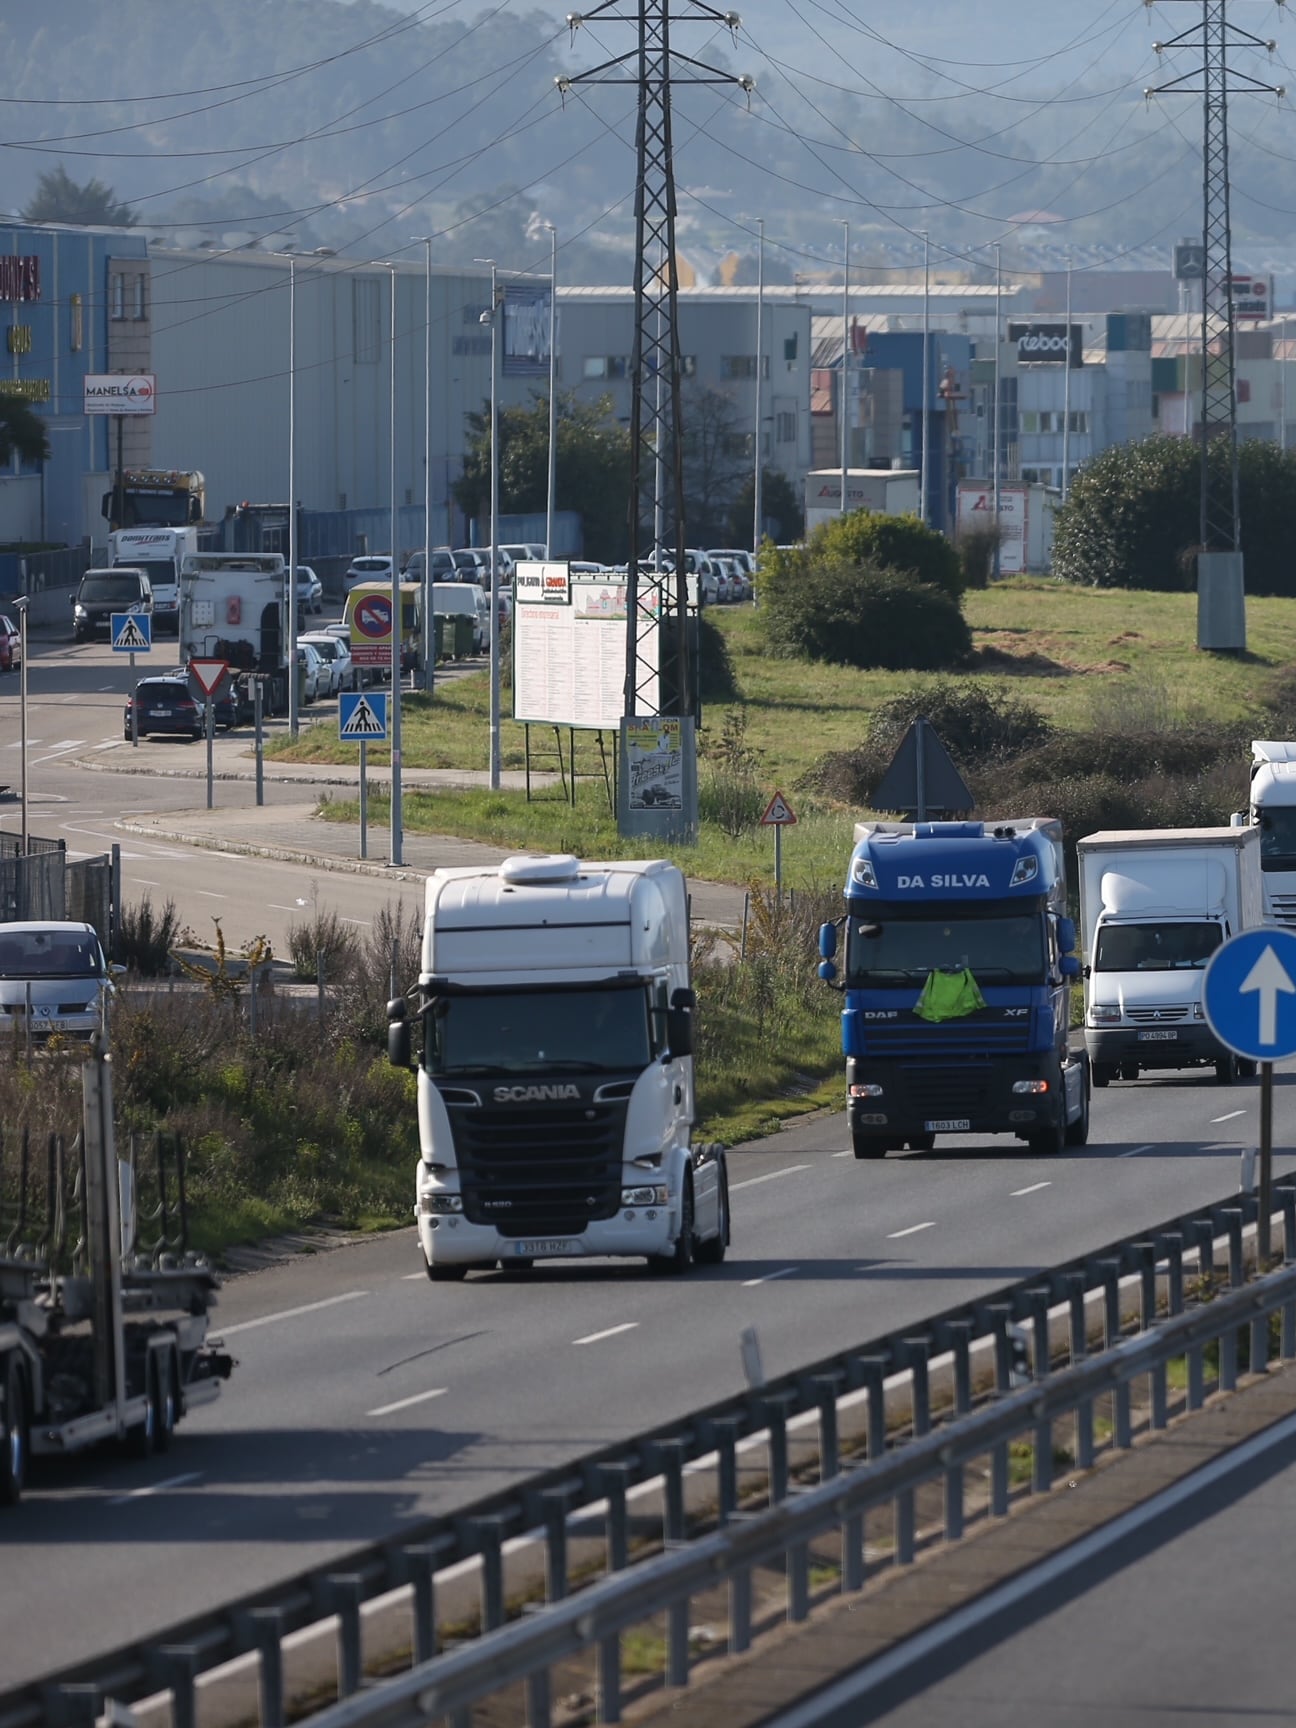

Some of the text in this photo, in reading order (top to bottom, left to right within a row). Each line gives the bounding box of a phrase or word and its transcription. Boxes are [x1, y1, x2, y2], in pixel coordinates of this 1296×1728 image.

[86, 386, 138, 396] MANELSA
[896, 873, 991, 889] DA SILVA
[864, 1008, 1029, 1020] DAF XF
[493, 1084, 580, 1102] SCANIA
